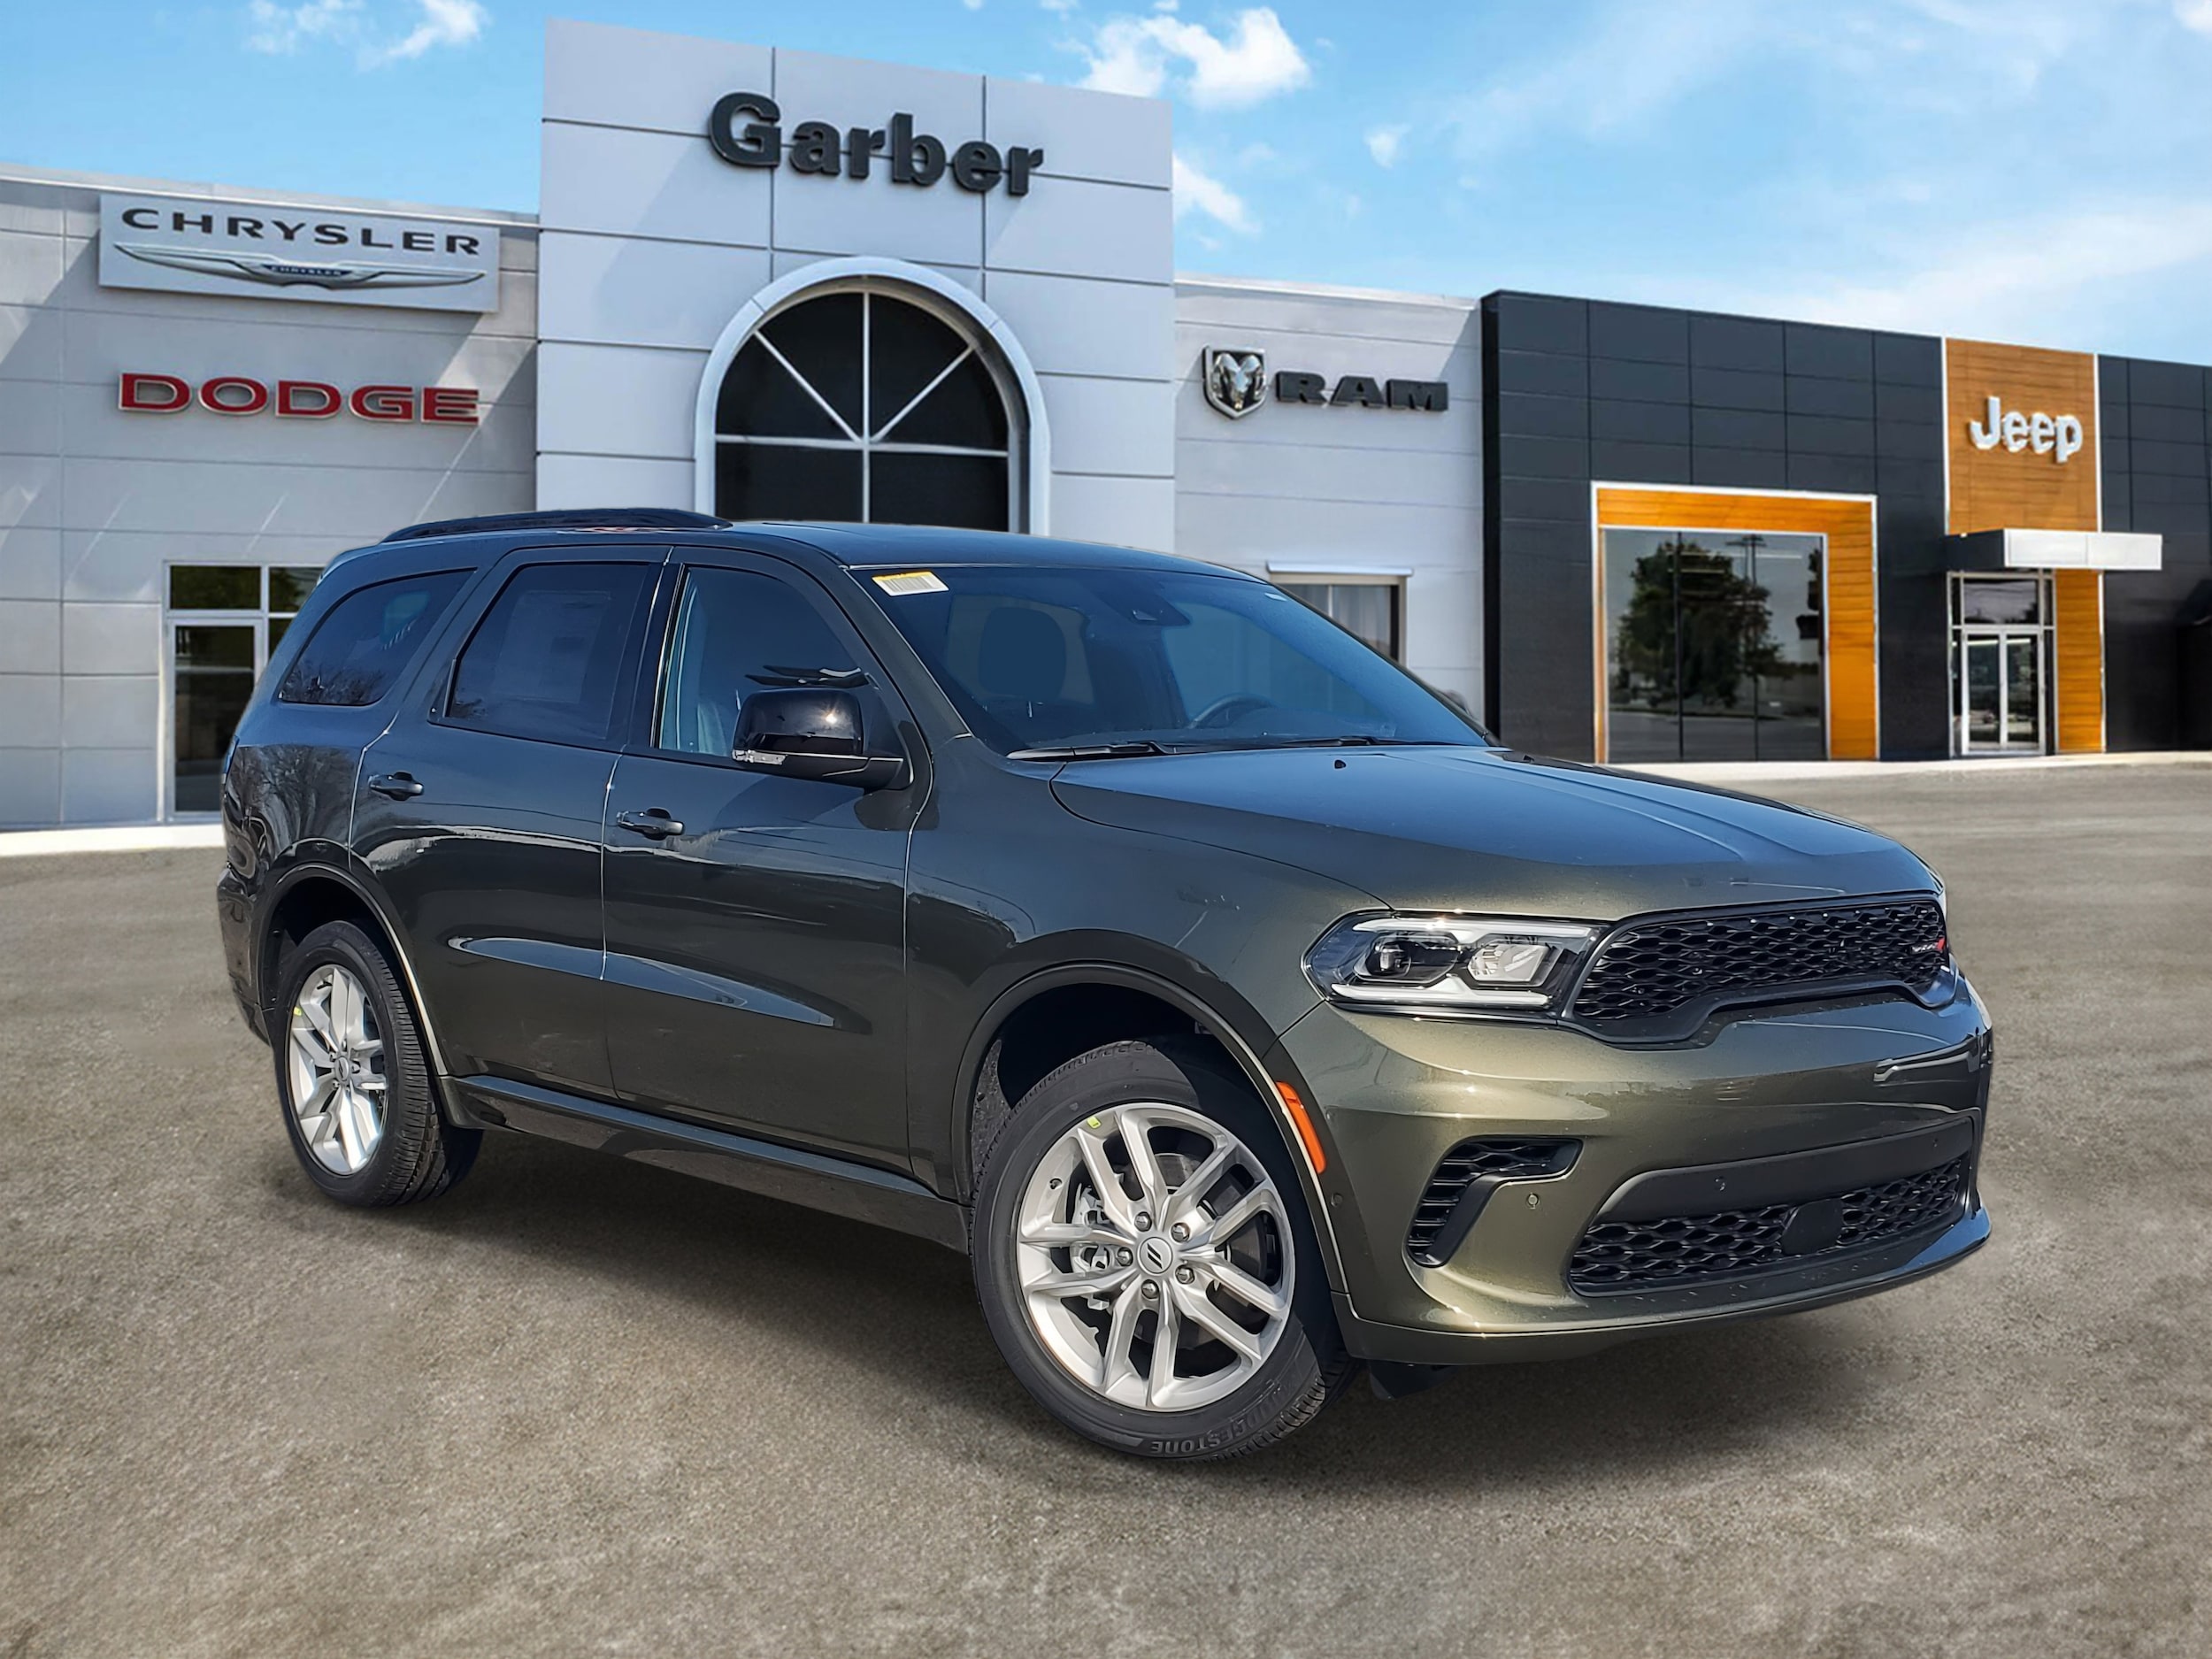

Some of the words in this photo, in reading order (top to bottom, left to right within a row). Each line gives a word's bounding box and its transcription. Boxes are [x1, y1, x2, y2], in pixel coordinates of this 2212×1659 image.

[710, 91, 1044, 196] Garber
[121, 208, 480, 255] CHRYSLER
[119, 373, 480, 425] DODGE
[1275, 370, 1449, 411] RAM
[1969, 396, 2083, 463] Jeep
